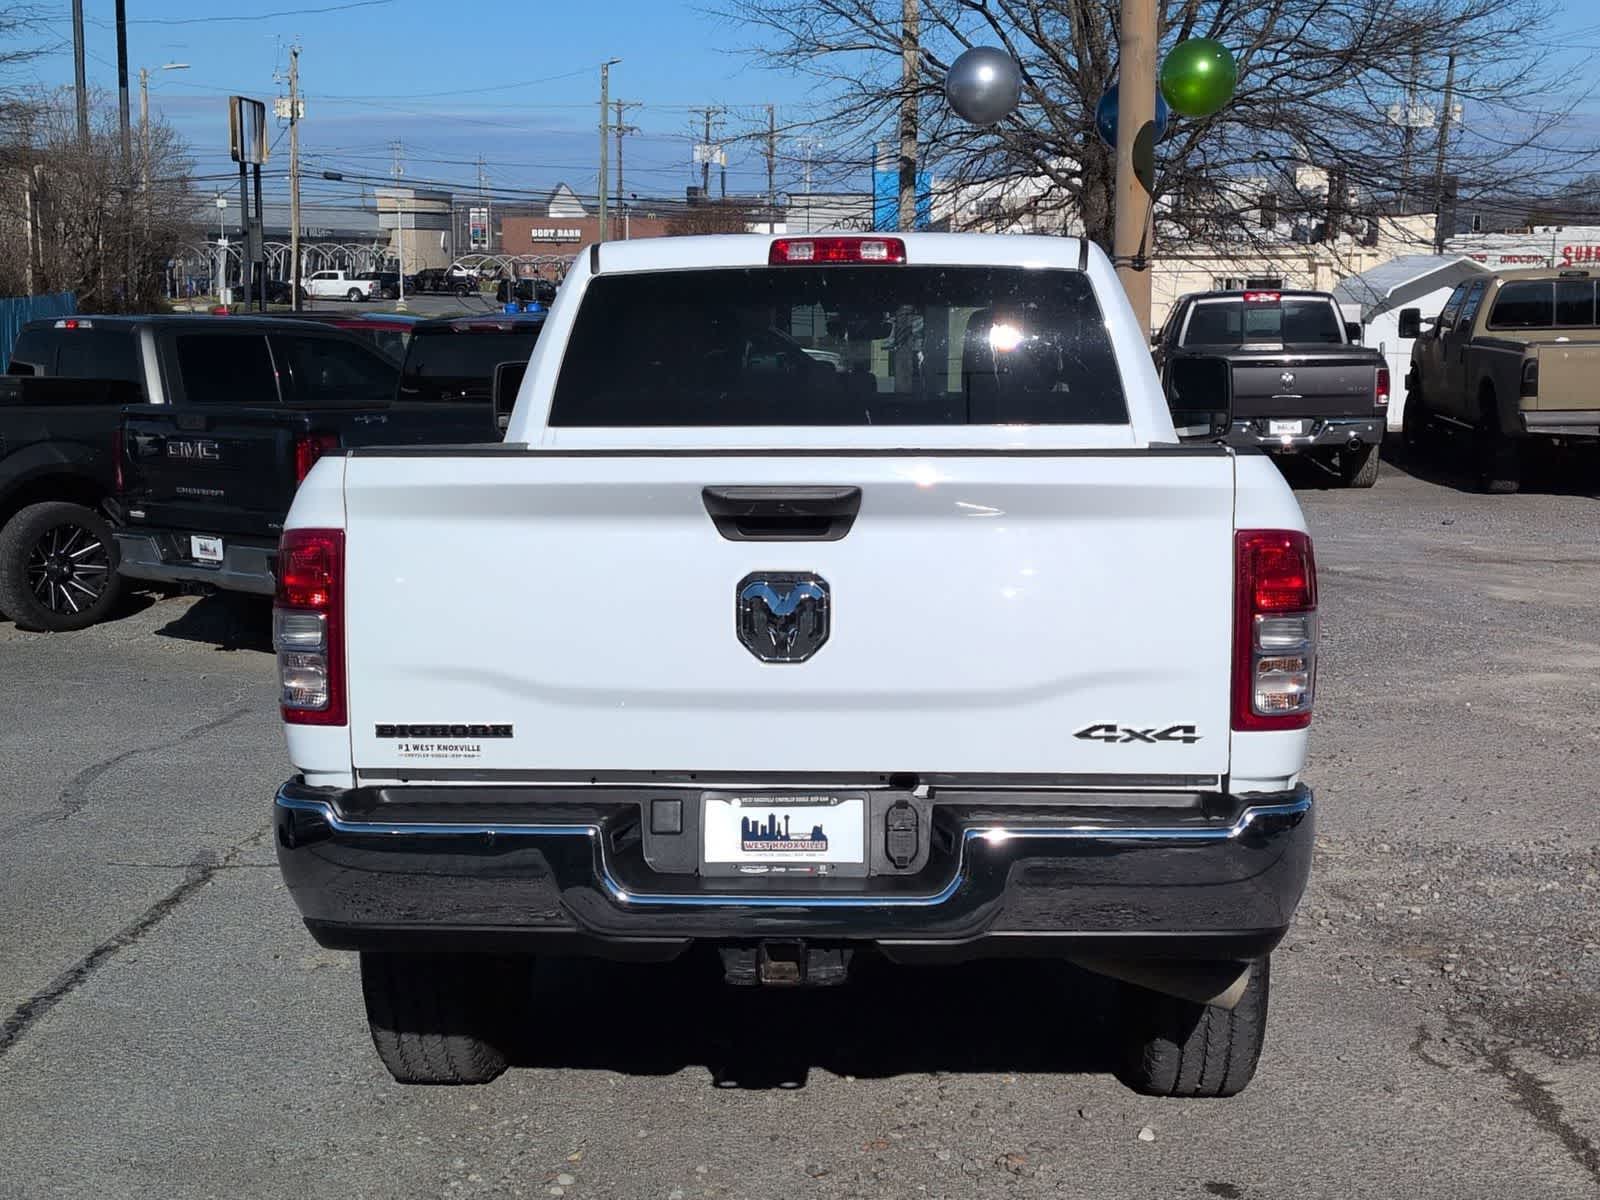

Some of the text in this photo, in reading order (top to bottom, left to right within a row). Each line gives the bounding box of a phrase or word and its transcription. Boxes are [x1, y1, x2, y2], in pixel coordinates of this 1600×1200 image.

[168, 440, 220, 460] GMC
[412, 744, 435, 752] WEST
[436, 744, 481, 752] KNOXVILLE
[745, 841, 826, 850] WEST KNOXVILLE
